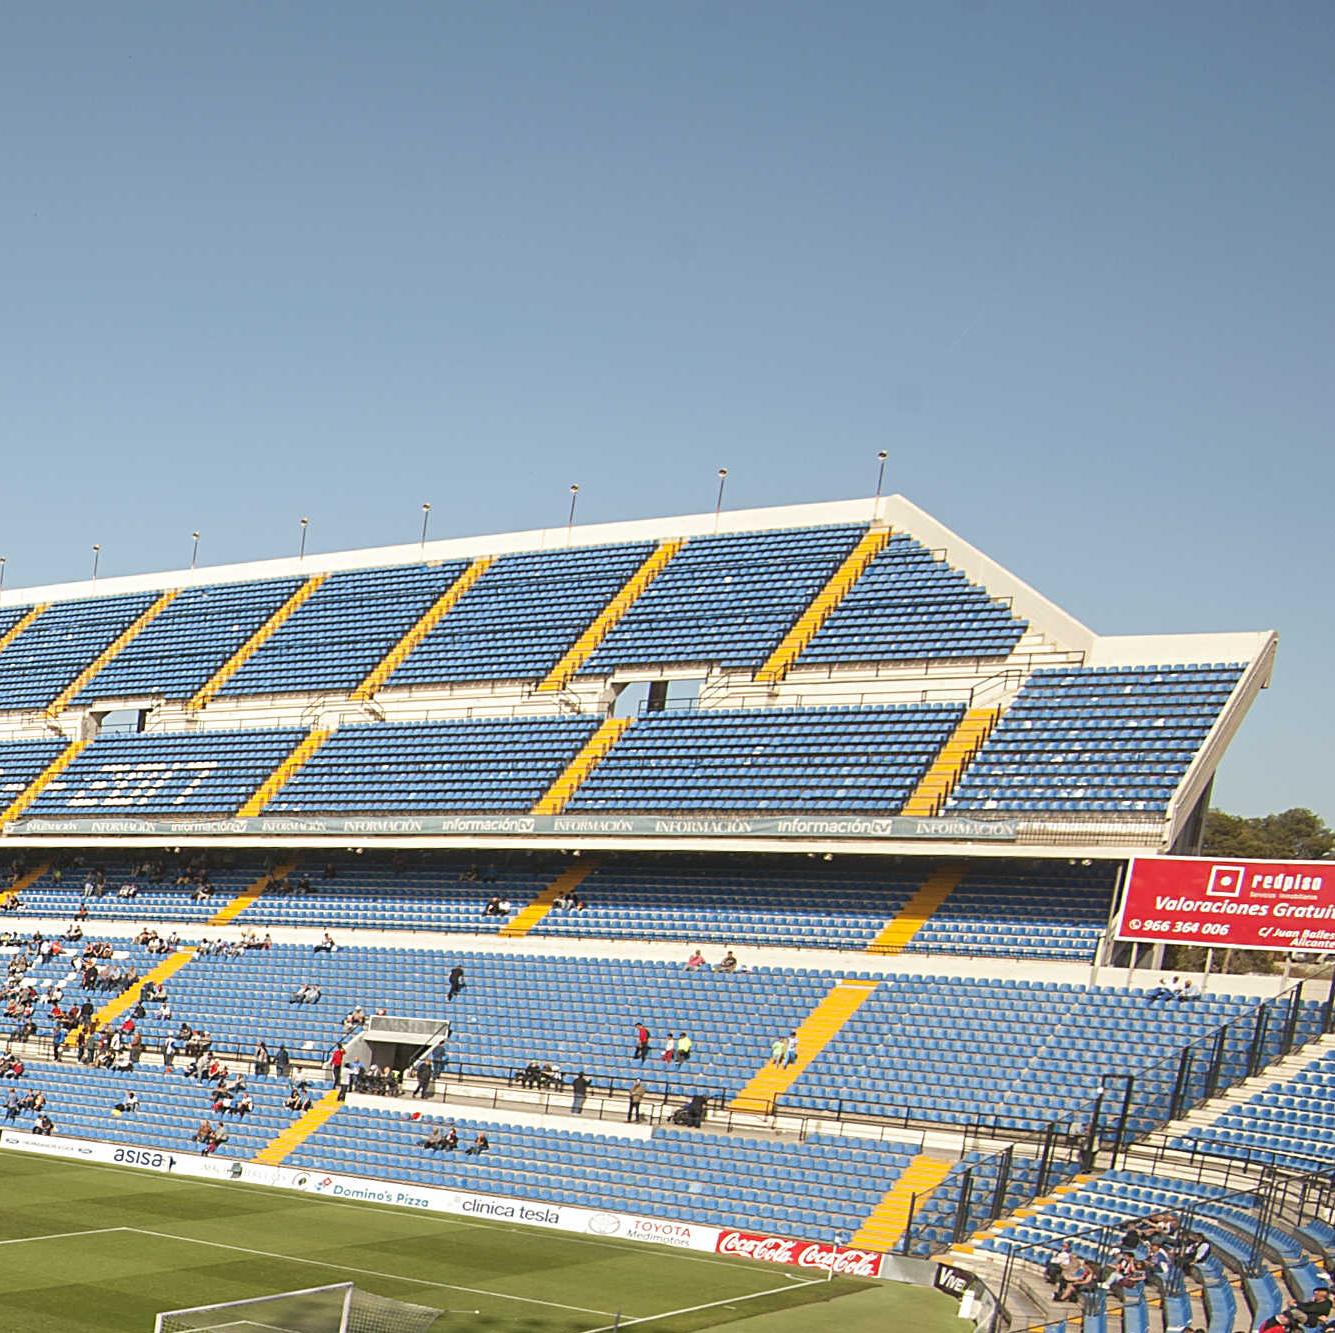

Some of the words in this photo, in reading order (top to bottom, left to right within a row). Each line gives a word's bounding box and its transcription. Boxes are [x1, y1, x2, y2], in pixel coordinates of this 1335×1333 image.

[554, 818, 634, 832] INFORMACIÓN
[656, 818, 753, 833] INFORMACIÓN
[1252, 873, 1323, 892] redpiso
[1154, 896, 1268, 916] Valoraciones
[1142, 919, 1176, 932] 966
[1177, 921, 1200, 934] 364
[1201, 923, 1230, 936] 006
[1273, 928, 1300, 938] Juan
[114, 1148, 163, 1167] asisa
[333, 1184, 393, 1202] Domino's
[396, 1193, 430, 1208] Pizza
[519, 1207, 560, 1225] tesla
[634, 1219, 692, 1238] TOYOTA
[627, 1229, 691, 1247] Medimotors
